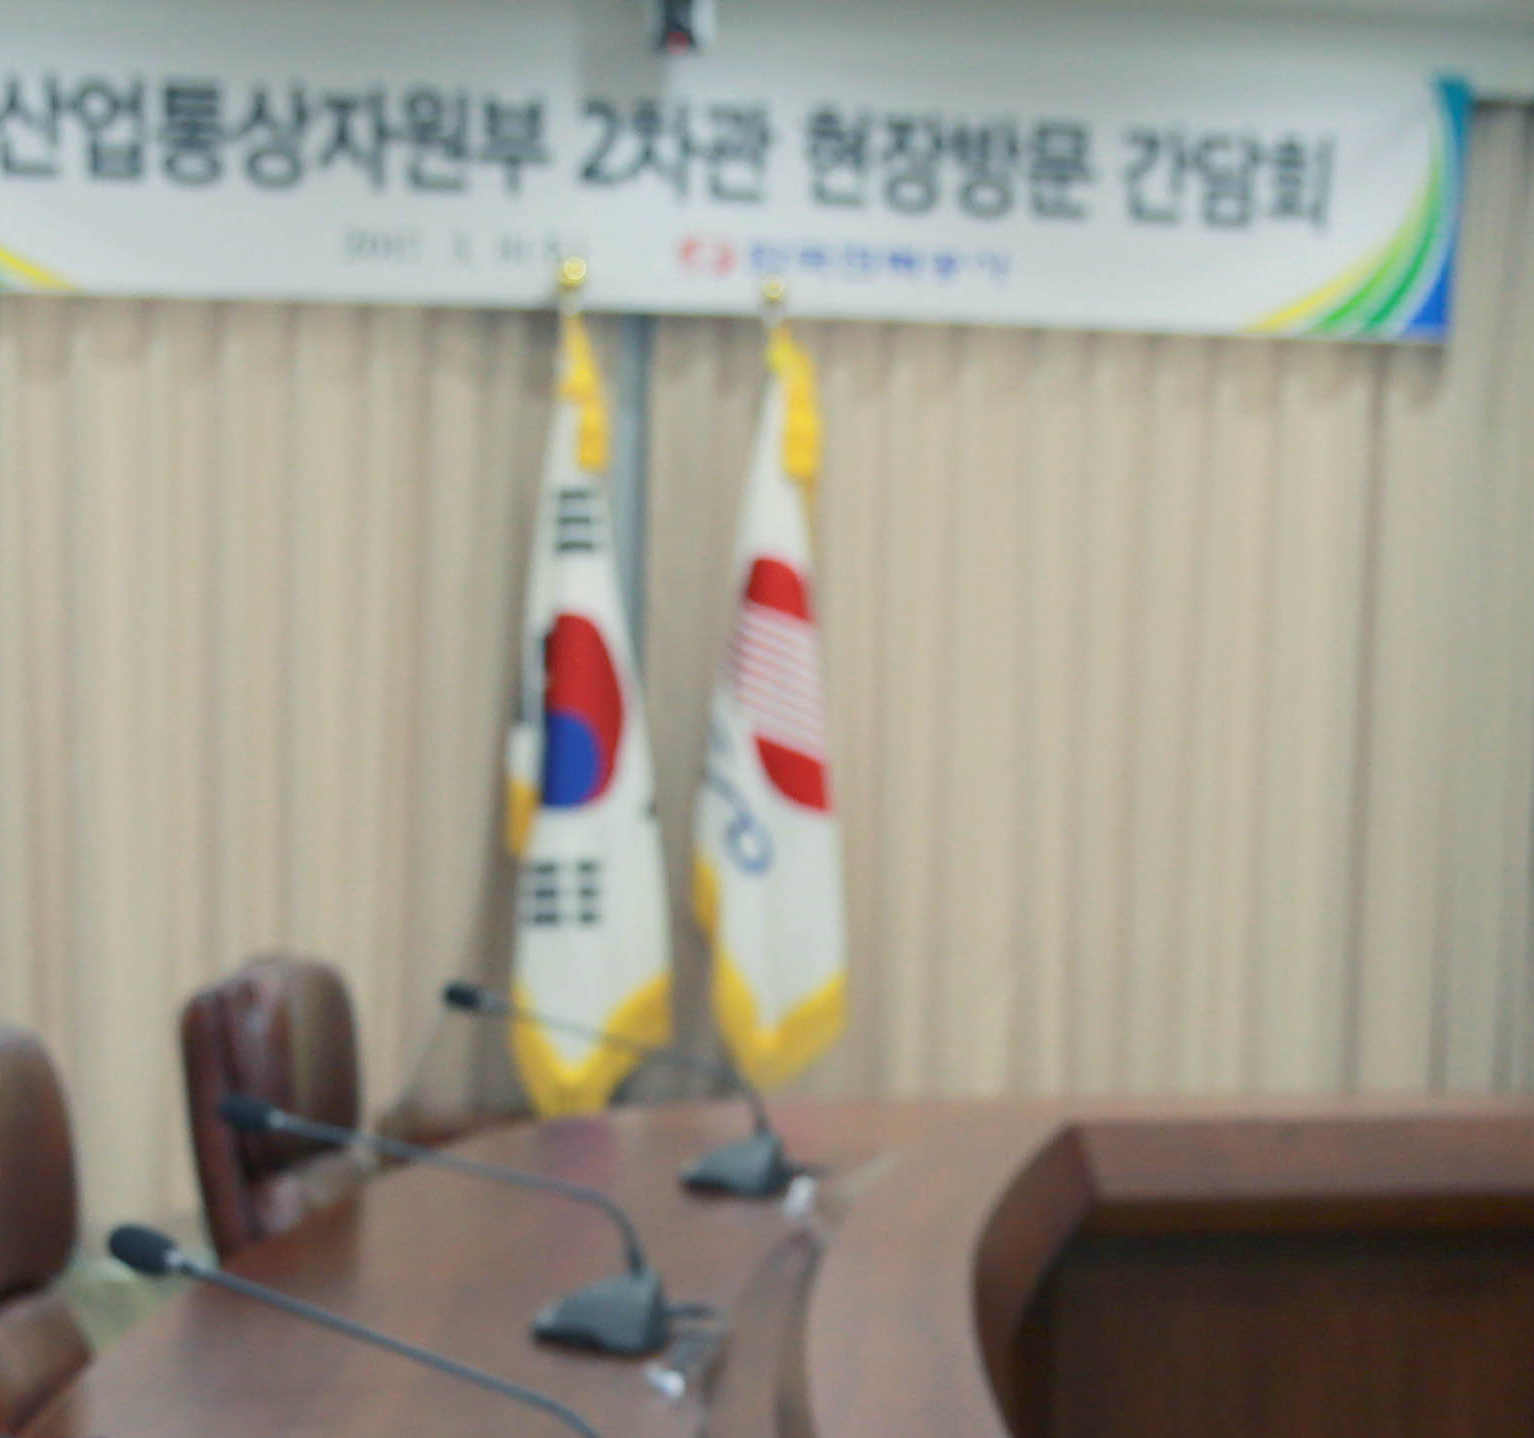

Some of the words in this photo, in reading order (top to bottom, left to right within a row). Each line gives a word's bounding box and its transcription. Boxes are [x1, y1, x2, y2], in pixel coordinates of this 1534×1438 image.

[577, 92, 775, 206] 2차관
[805, 102, 1093, 222] 현장방문
[1121, 128, 1337, 236] 간담회
